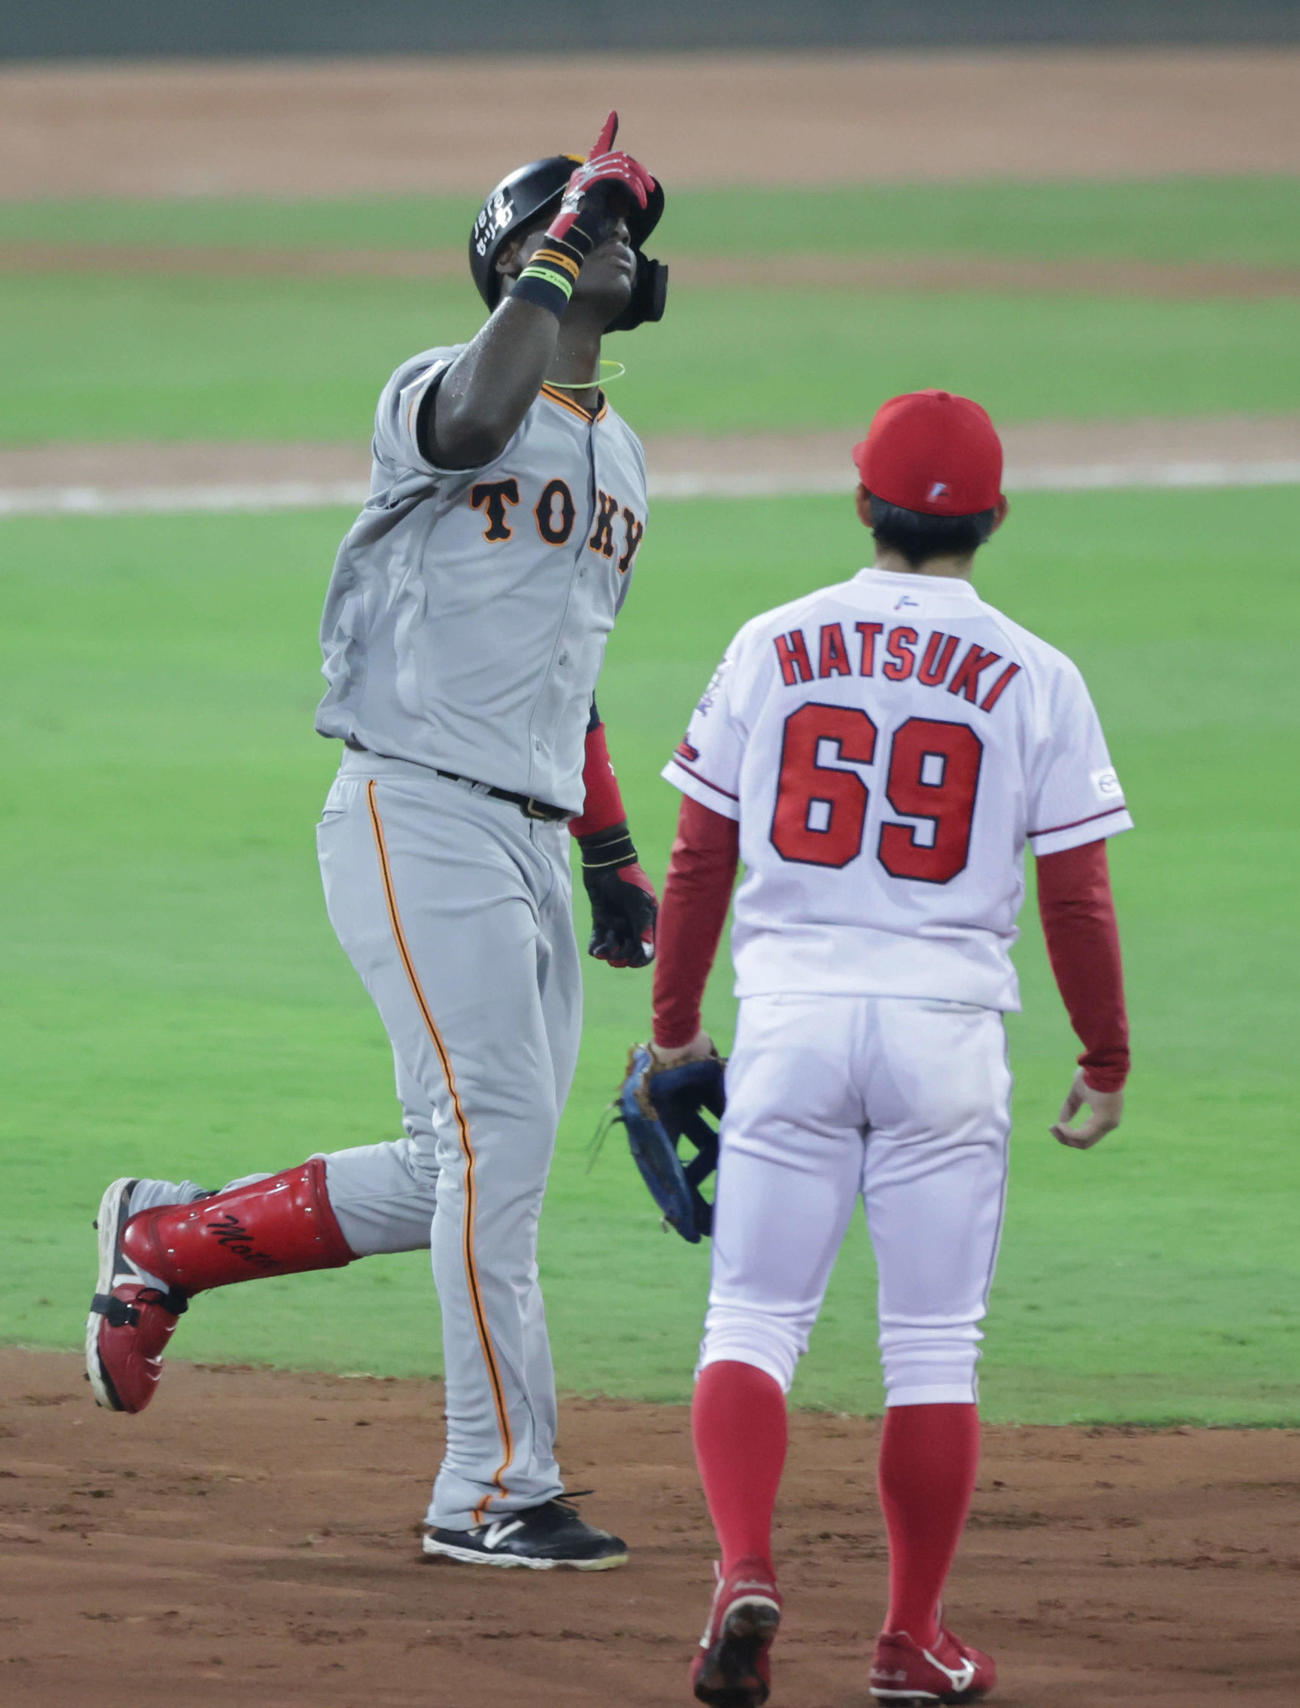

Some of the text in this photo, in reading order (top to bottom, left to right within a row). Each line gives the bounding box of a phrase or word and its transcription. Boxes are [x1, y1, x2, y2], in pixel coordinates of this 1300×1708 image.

[469, 477, 643, 575] TOKY
[773, 621, 1022, 714] HATSUKI
[769, 701, 984, 885] 69
